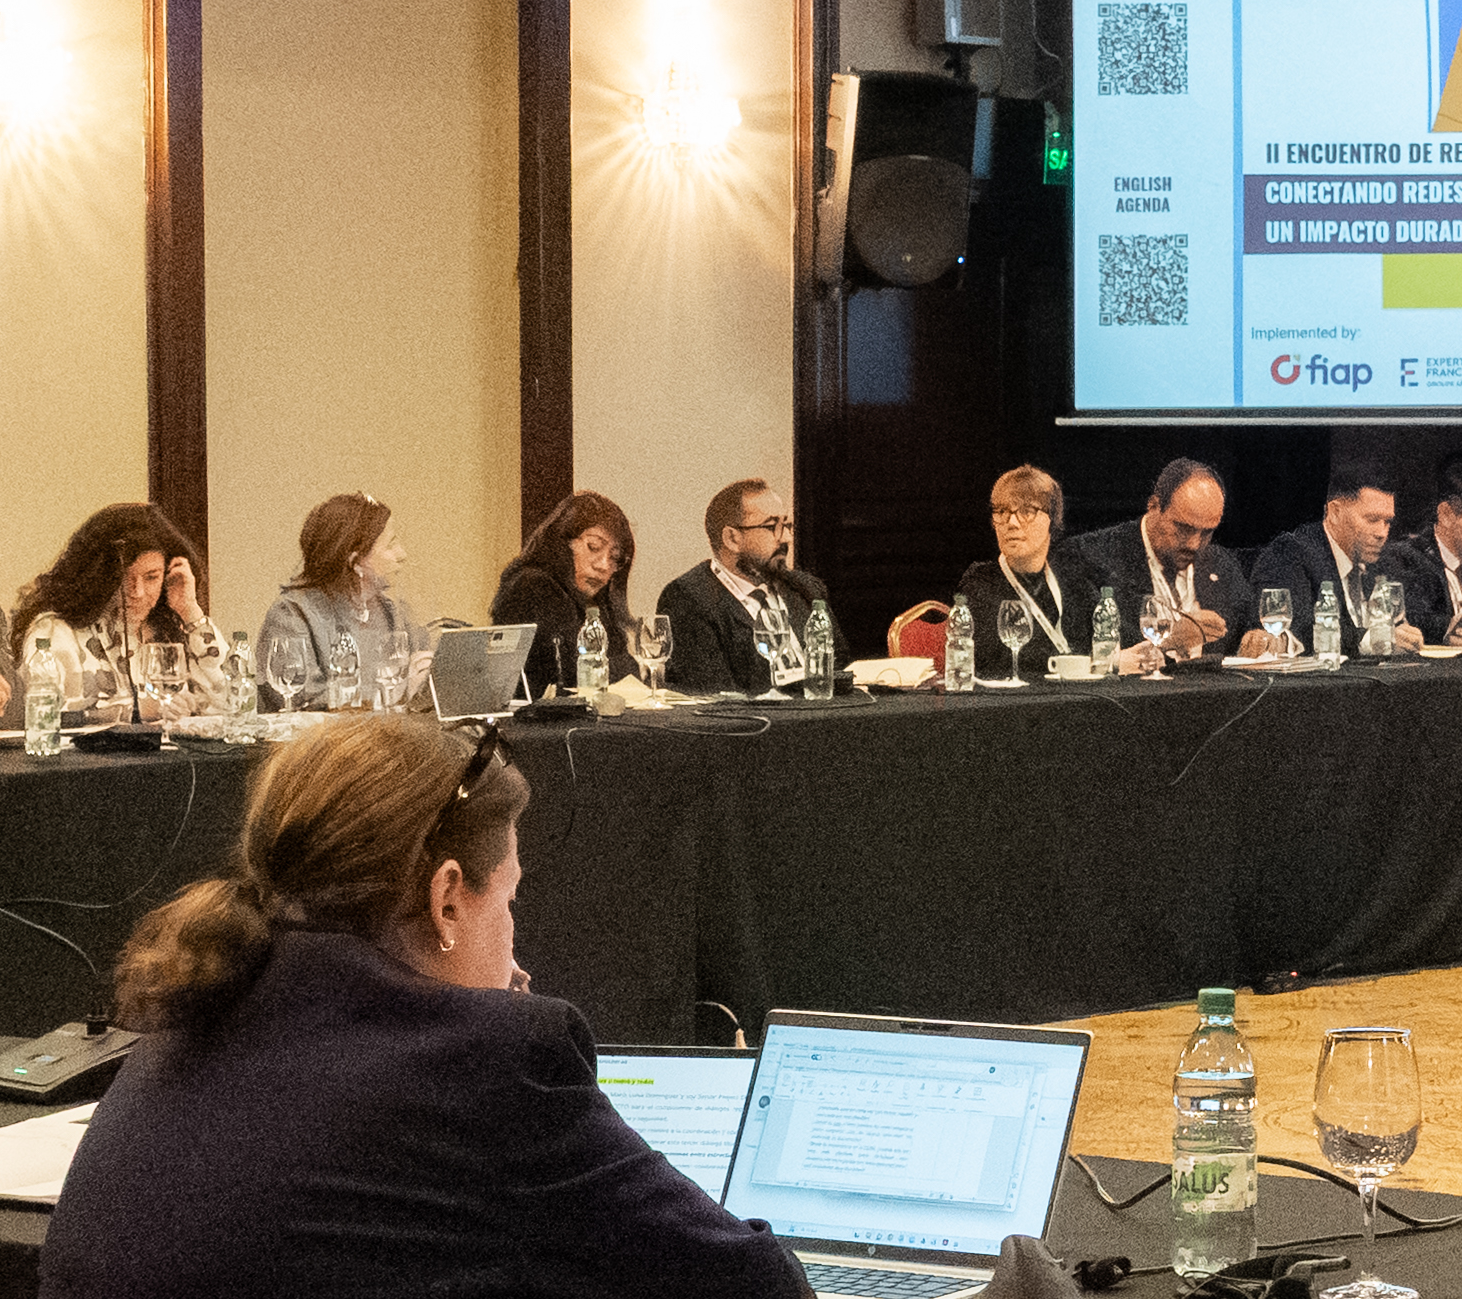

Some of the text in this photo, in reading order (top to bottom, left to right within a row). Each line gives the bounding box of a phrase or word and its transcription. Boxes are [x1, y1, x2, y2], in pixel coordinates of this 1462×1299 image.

[1266, 143, 1279, 163] II
[1287, 143, 1401, 163] ENCUENTRO
[1409, 143, 1433, 163] DE
[1114, 177, 1172, 191] ENGLISH
[1265, 181, 1397, 204] CONECTANDO
[1116, 198, 1170, 212] AGENDA
[1265, 220, 1294, 243] UN
[1300, 220, 1390, 243] IMPACTO
[1251, 327, 1337, 341] Implemented
[1305, 354, 1373, 392] fiap
